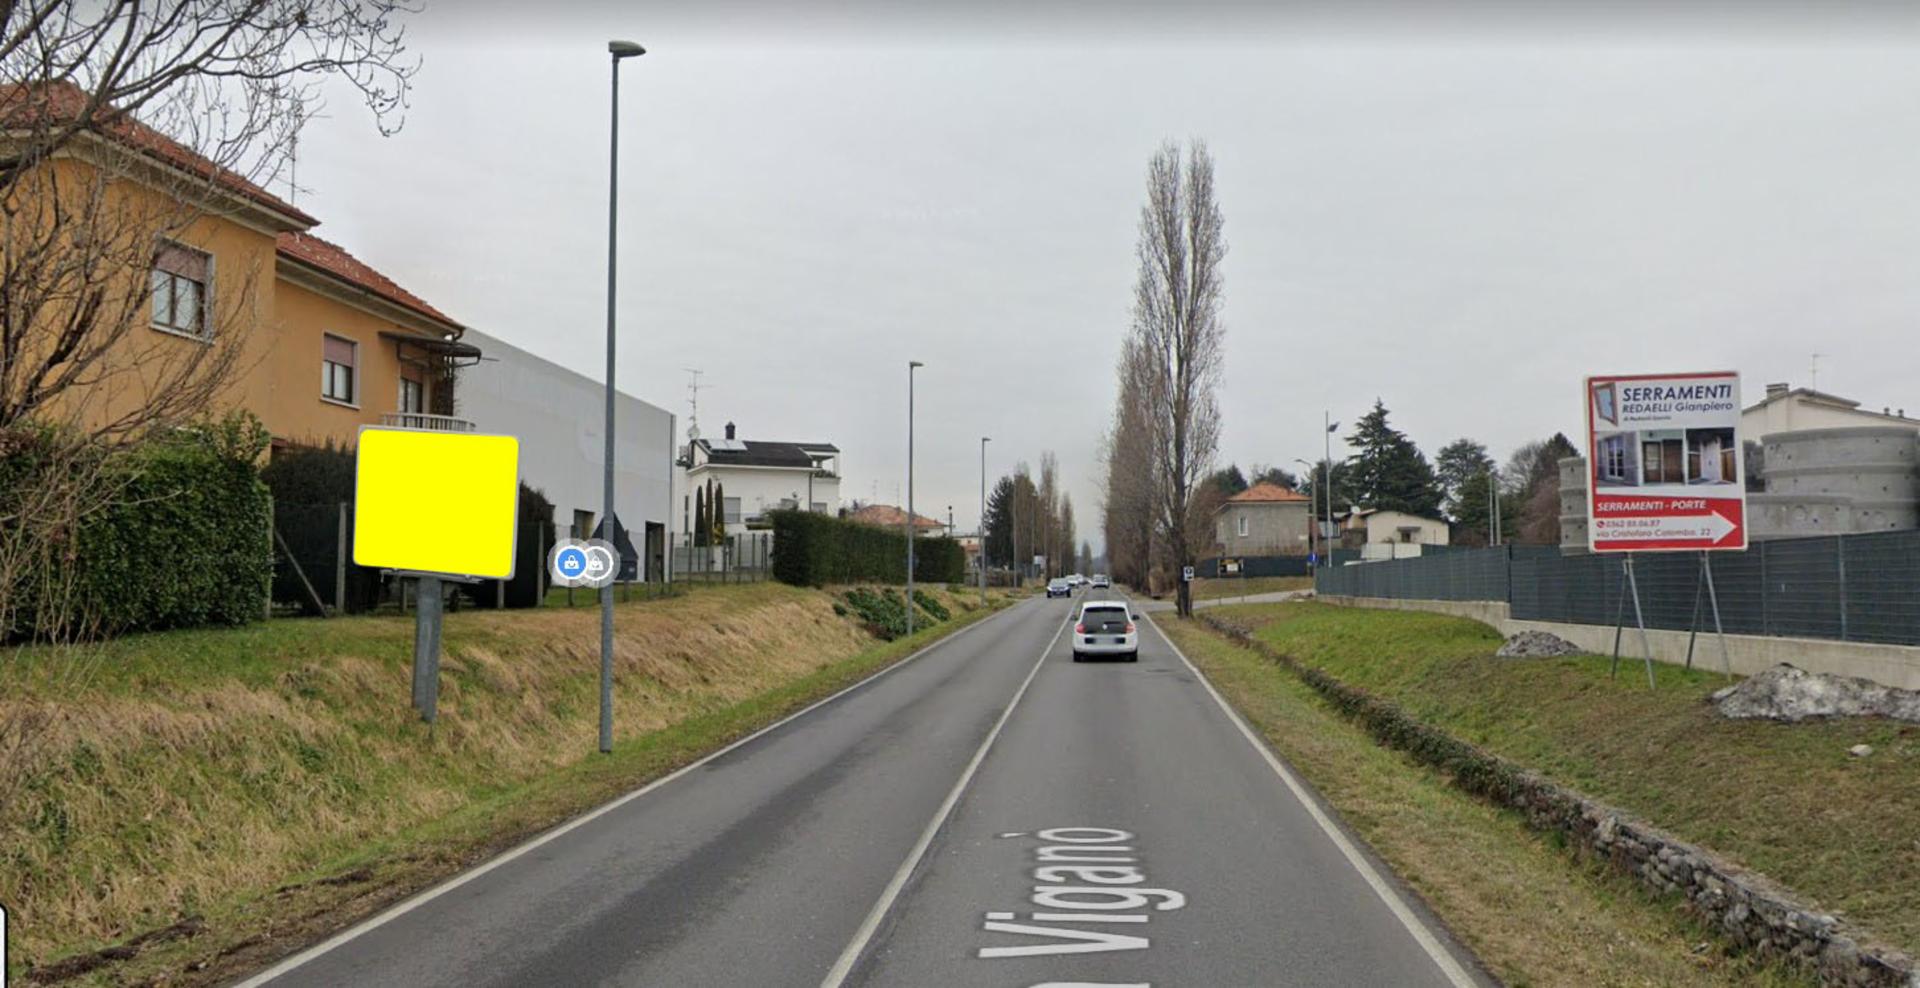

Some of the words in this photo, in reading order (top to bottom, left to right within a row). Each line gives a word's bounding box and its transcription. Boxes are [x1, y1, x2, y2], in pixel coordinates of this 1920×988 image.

[1623, 385, 1731, 401] SERRAMENTI
[1623, 403, 1672, 413] REDAELLI
[1675, 402, 1733, 412] Gianpiero
[1597, 501, 1664, 511] SERRAMENTI
[1671, 500, 1707, 509] PORTE
